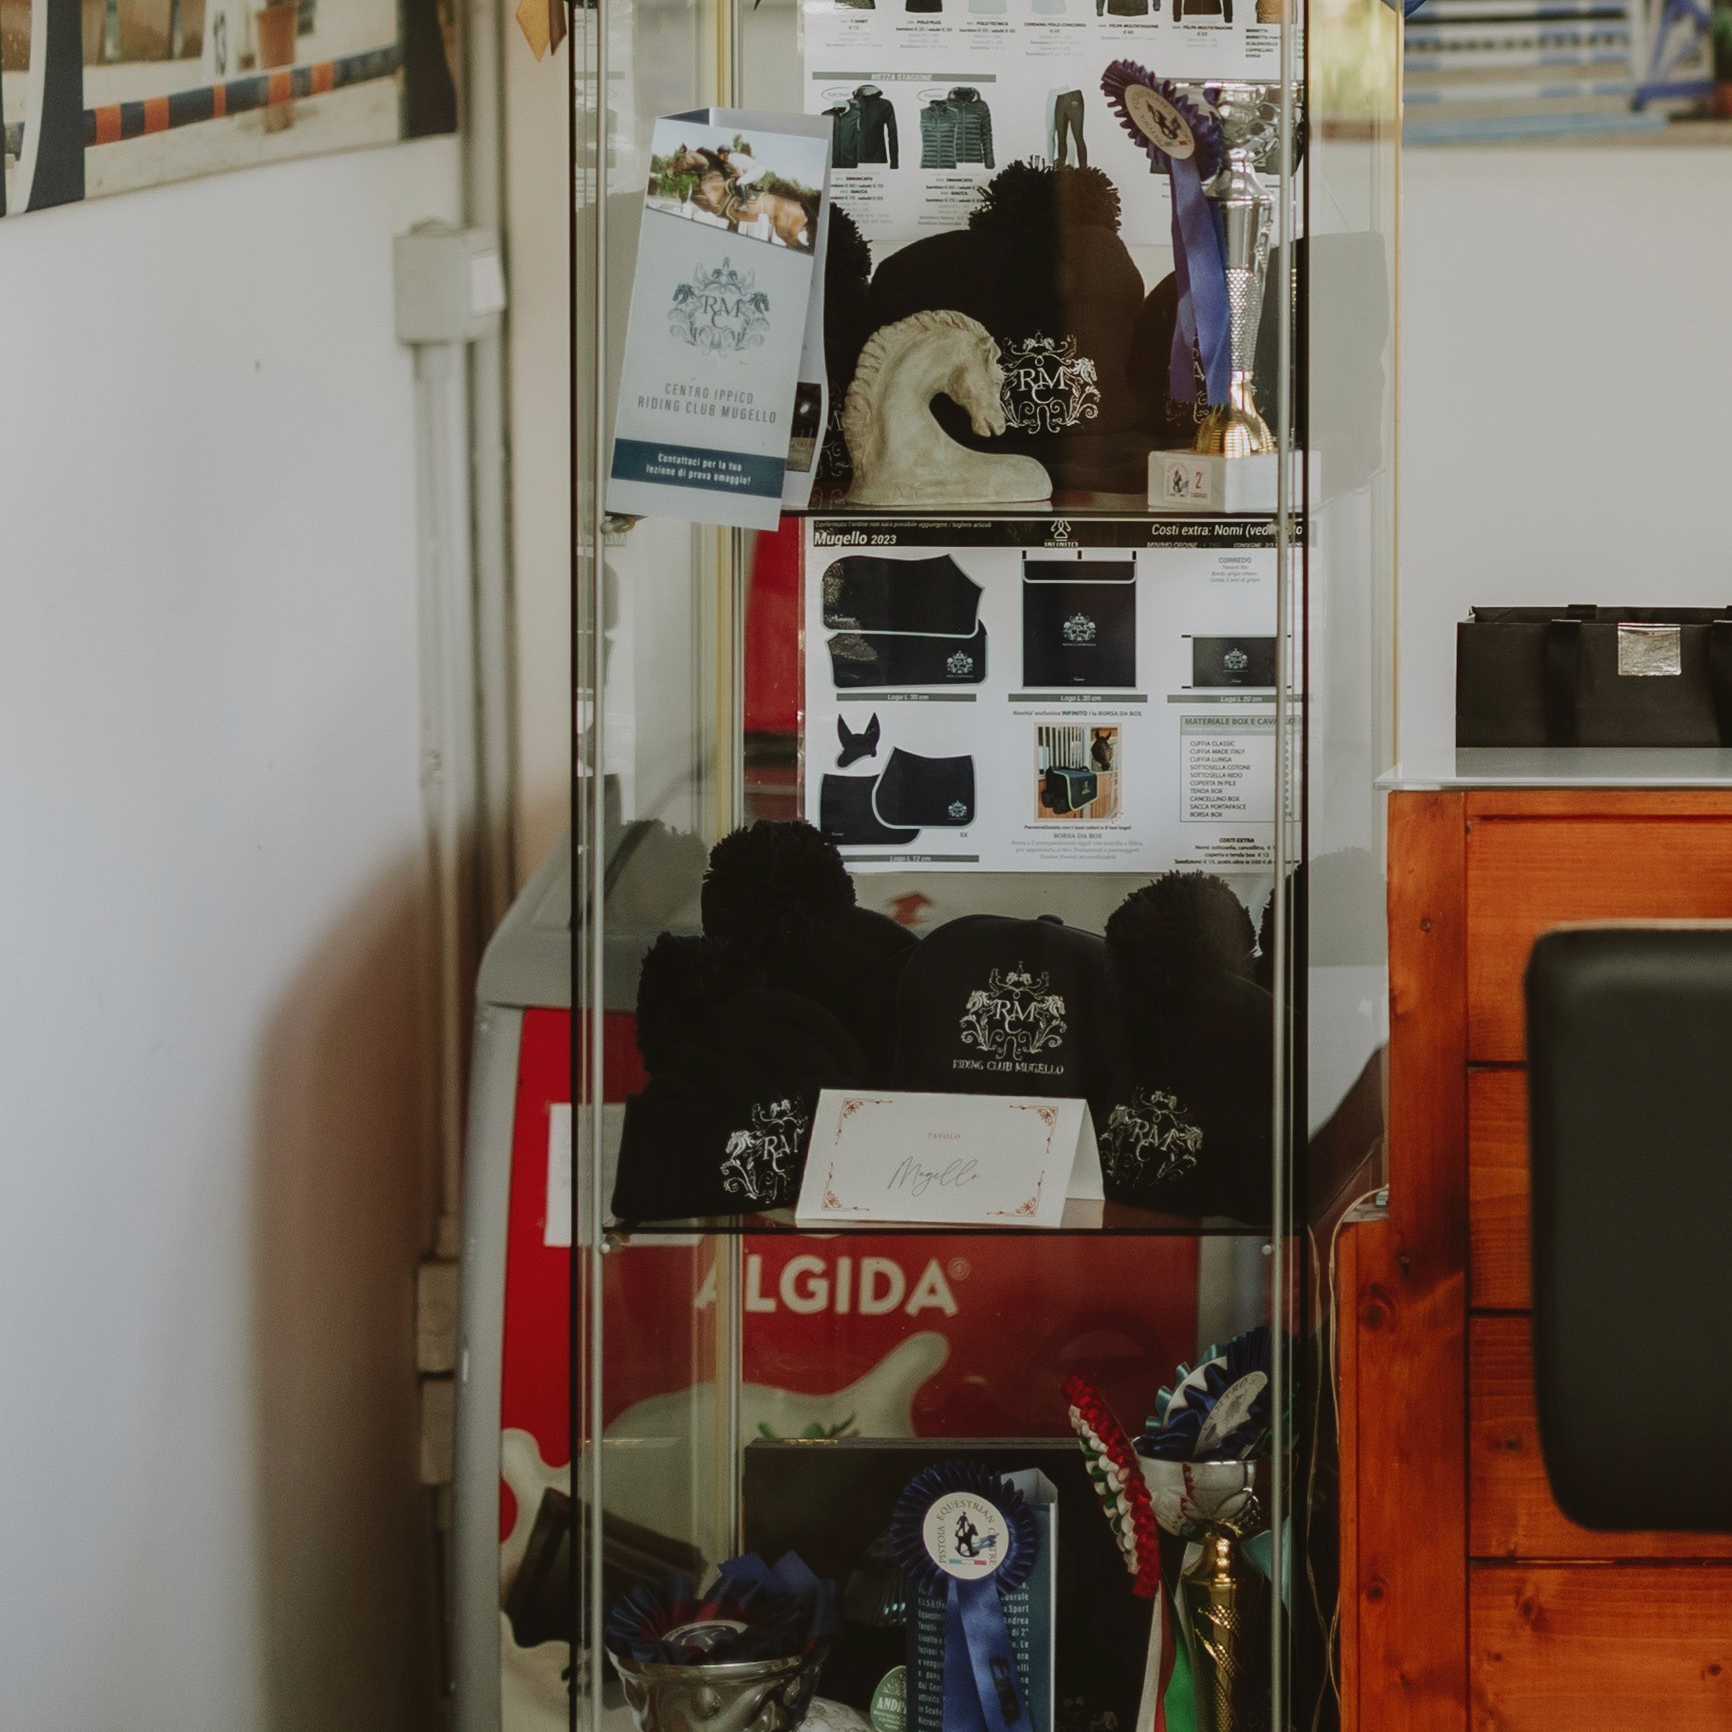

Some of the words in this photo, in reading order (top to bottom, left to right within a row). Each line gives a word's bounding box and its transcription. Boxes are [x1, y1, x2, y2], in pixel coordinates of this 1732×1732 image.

[665, 383, 710, 400] CENTRO
[714, 388, 754, 405] IPPICO
[637, 396, 680, 413] RIDING
[685, 401, 716, 417] CLUB
[721, 405, 777, 424] MUGELLO
[657, 452, 701, 467] Contattaci
[702, 459, 716, 470] per
[718, 460, 727, 470] la
[728, 463, 743, 473] tua
[646, 463, 676, 477] lezione
[677, 467, 687, 478] di
[688, 470, 712, 482] prova
[713, 474, 752, 487] omaggio!
[813, 530, 868, 547] Mugello
[870, 534, 897, 545] 2023
[1151, 523, 1179, 536] Costi
[1181, 524, 1212, 536] extra:
[1214, 524, 1243, 536] Nomi
[1218, 556, 1252, 564] CORREDO
[1184, 717, 1231, 726] MATERIALE
[1231, 718, 1249, 726] BOX
[1015, 1062, 1065, 1076] MUGELLO
[886, 1154, 981, 1198] Mugello
[936, 1498, 996, 1524] EQUESTRIAN
[937, 1525, 948, 1565] PISTOIA
[1009, 1604, 1029, 1614] Sport
